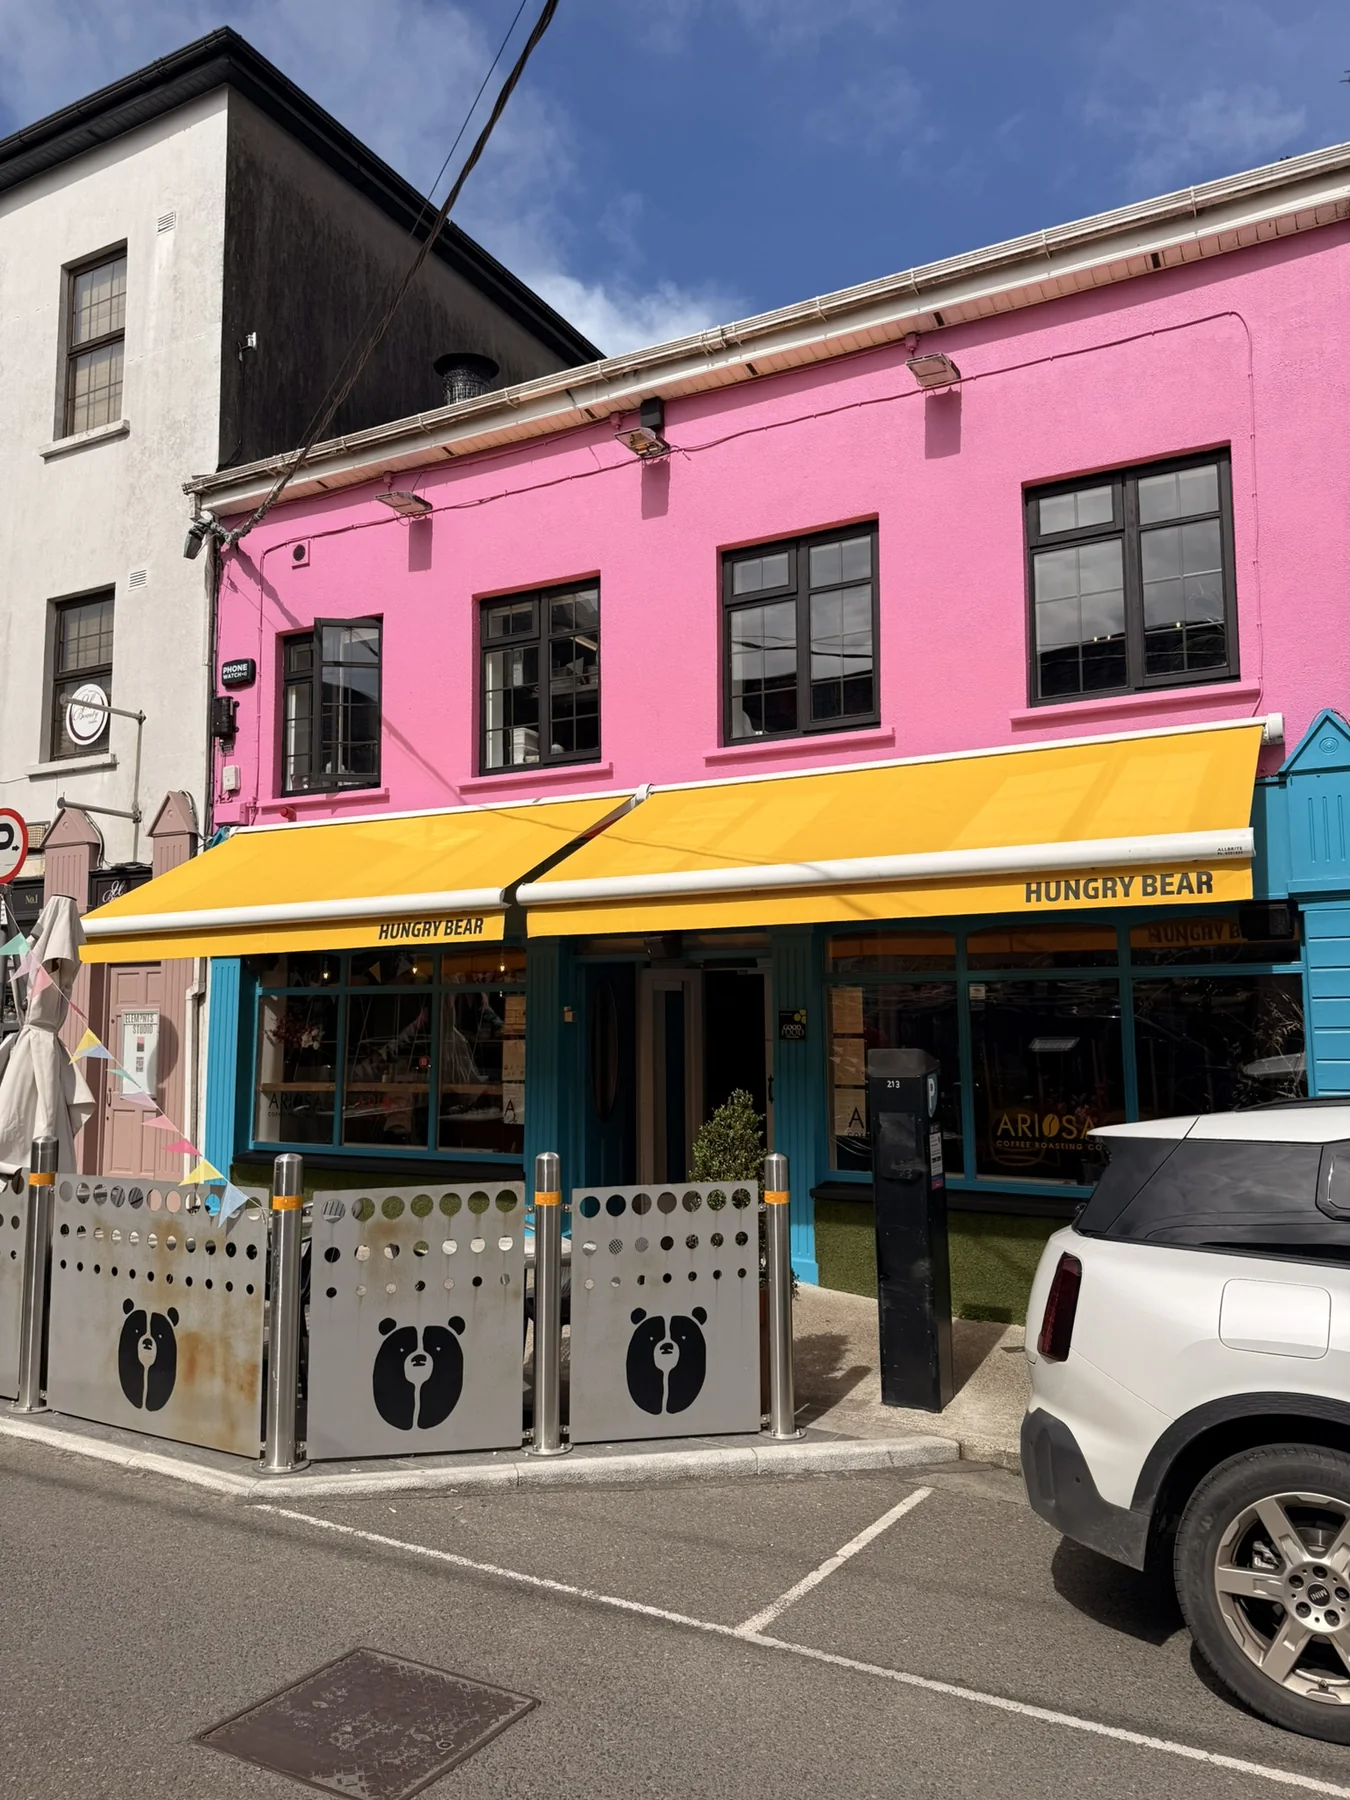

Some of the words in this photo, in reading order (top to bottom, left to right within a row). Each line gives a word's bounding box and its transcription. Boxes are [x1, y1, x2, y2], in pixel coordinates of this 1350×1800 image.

[223, 663, 248, 674] PHONE
[223, 671, 242, 680] WATCH
[1025, 875, 1135, 903] HUNGRY
[1141, 871, 1213, 897] BEAR
[378, 920, 442, 940] HUNGRY
[444, 918, 484, 936] BEAR
[782, 1023, 803, 1031] GOOD
[886, 1080, 900, 1089] 213
[996, 1112, 1096, 1140] ARIOSA
[996, 1140, 1031, 1149] COFFEE
[1034, 1141, 1084, 1151] ROASTING
[1310, 1588, 1328, 1601] MINI
